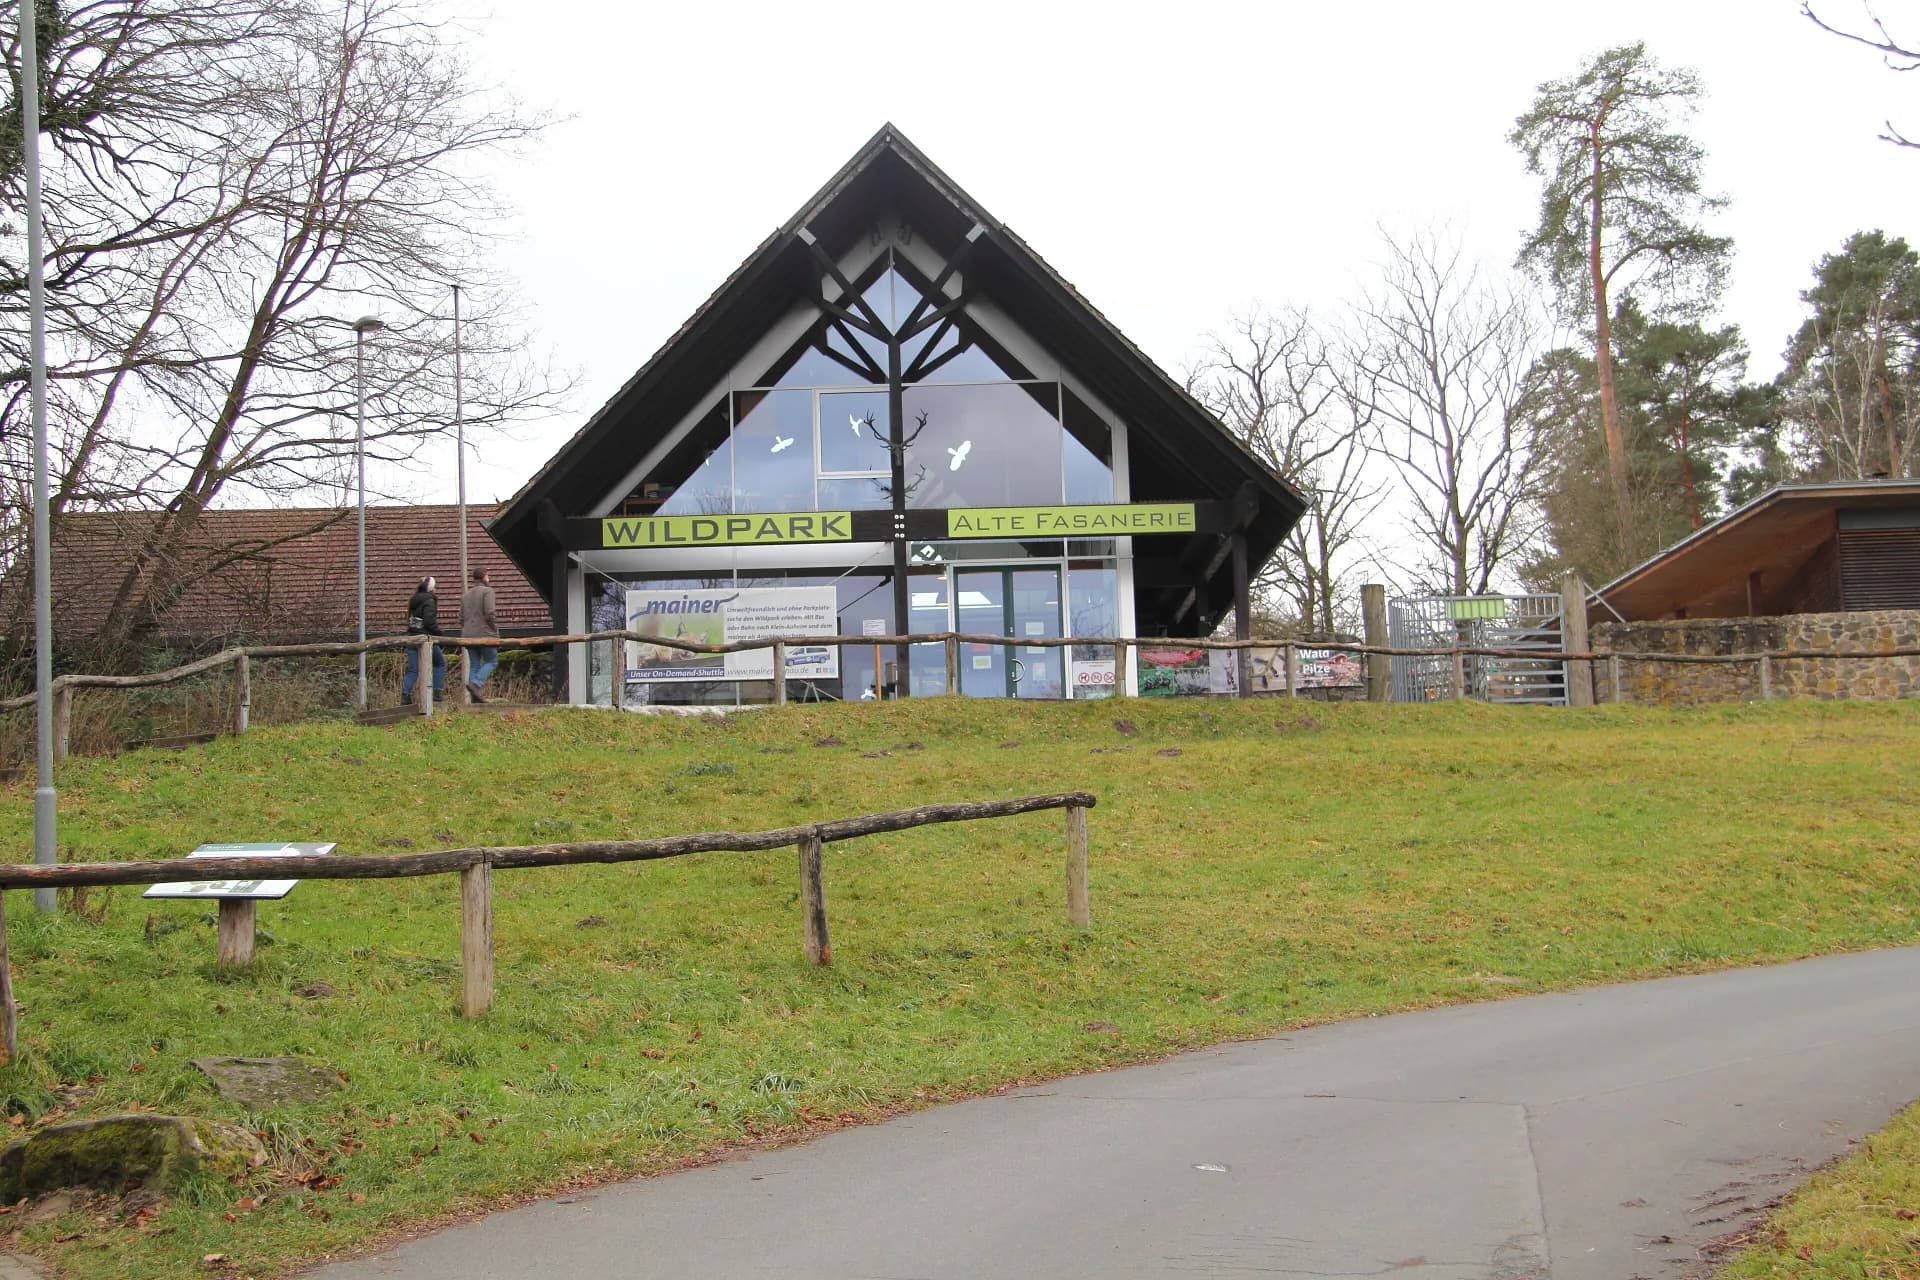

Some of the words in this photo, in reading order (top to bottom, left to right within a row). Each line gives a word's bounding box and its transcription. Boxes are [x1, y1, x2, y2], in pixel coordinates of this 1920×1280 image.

[607, 515, 848, 543] WILDPARK
[953, 514, 1026, 532] ALTE
[1036, 512, 1192, 530] FASANERIE
[643, 594, 722, 615] mainer
[1299, 649, 1330, 659] Wald
[652, 669, 724, 678] On-Demand-Shuttle
[1302, 663, 1331, 674] Pilze
